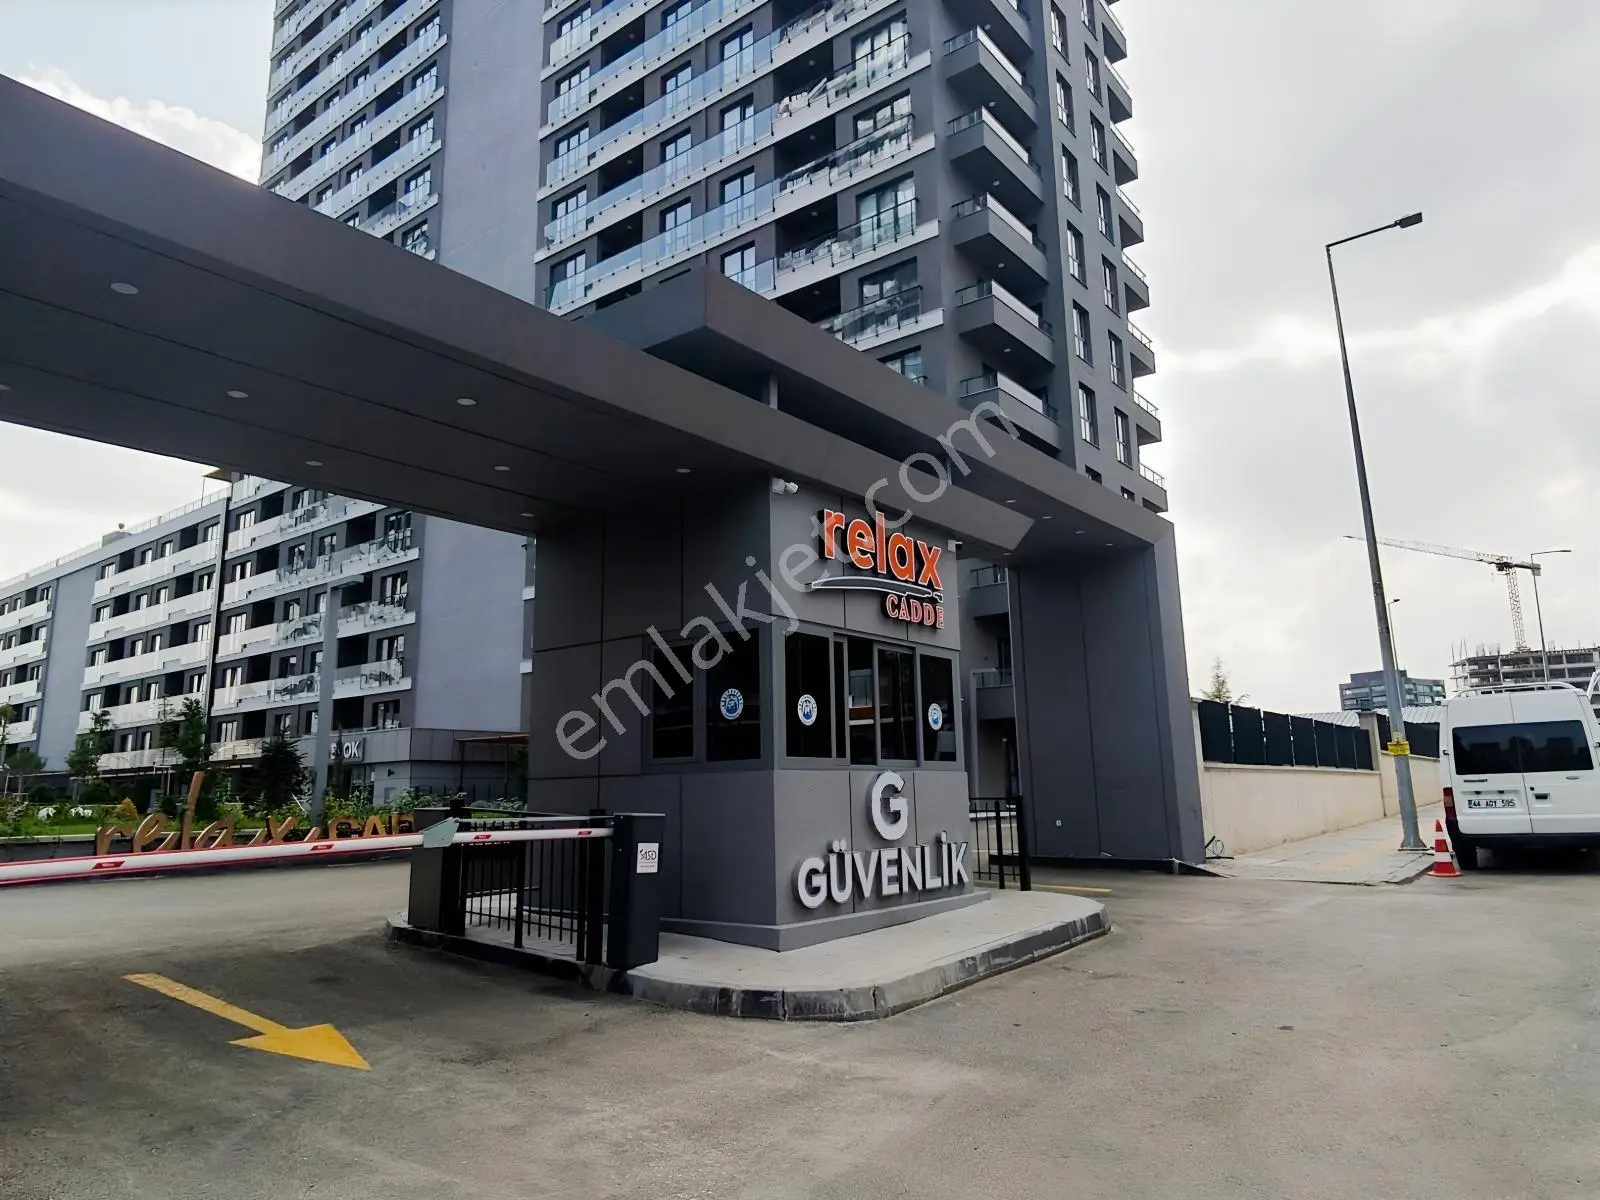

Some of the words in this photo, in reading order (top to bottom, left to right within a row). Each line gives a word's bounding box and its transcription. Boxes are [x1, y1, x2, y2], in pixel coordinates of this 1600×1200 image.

[822, 508, 943, 590] relax
[885, 594, 945, 628] CADDE
[331, 740, 360, 760] BOK
[871, 770, 909, 841] G
[797, 830, 969, 909] GÜVENLİK
